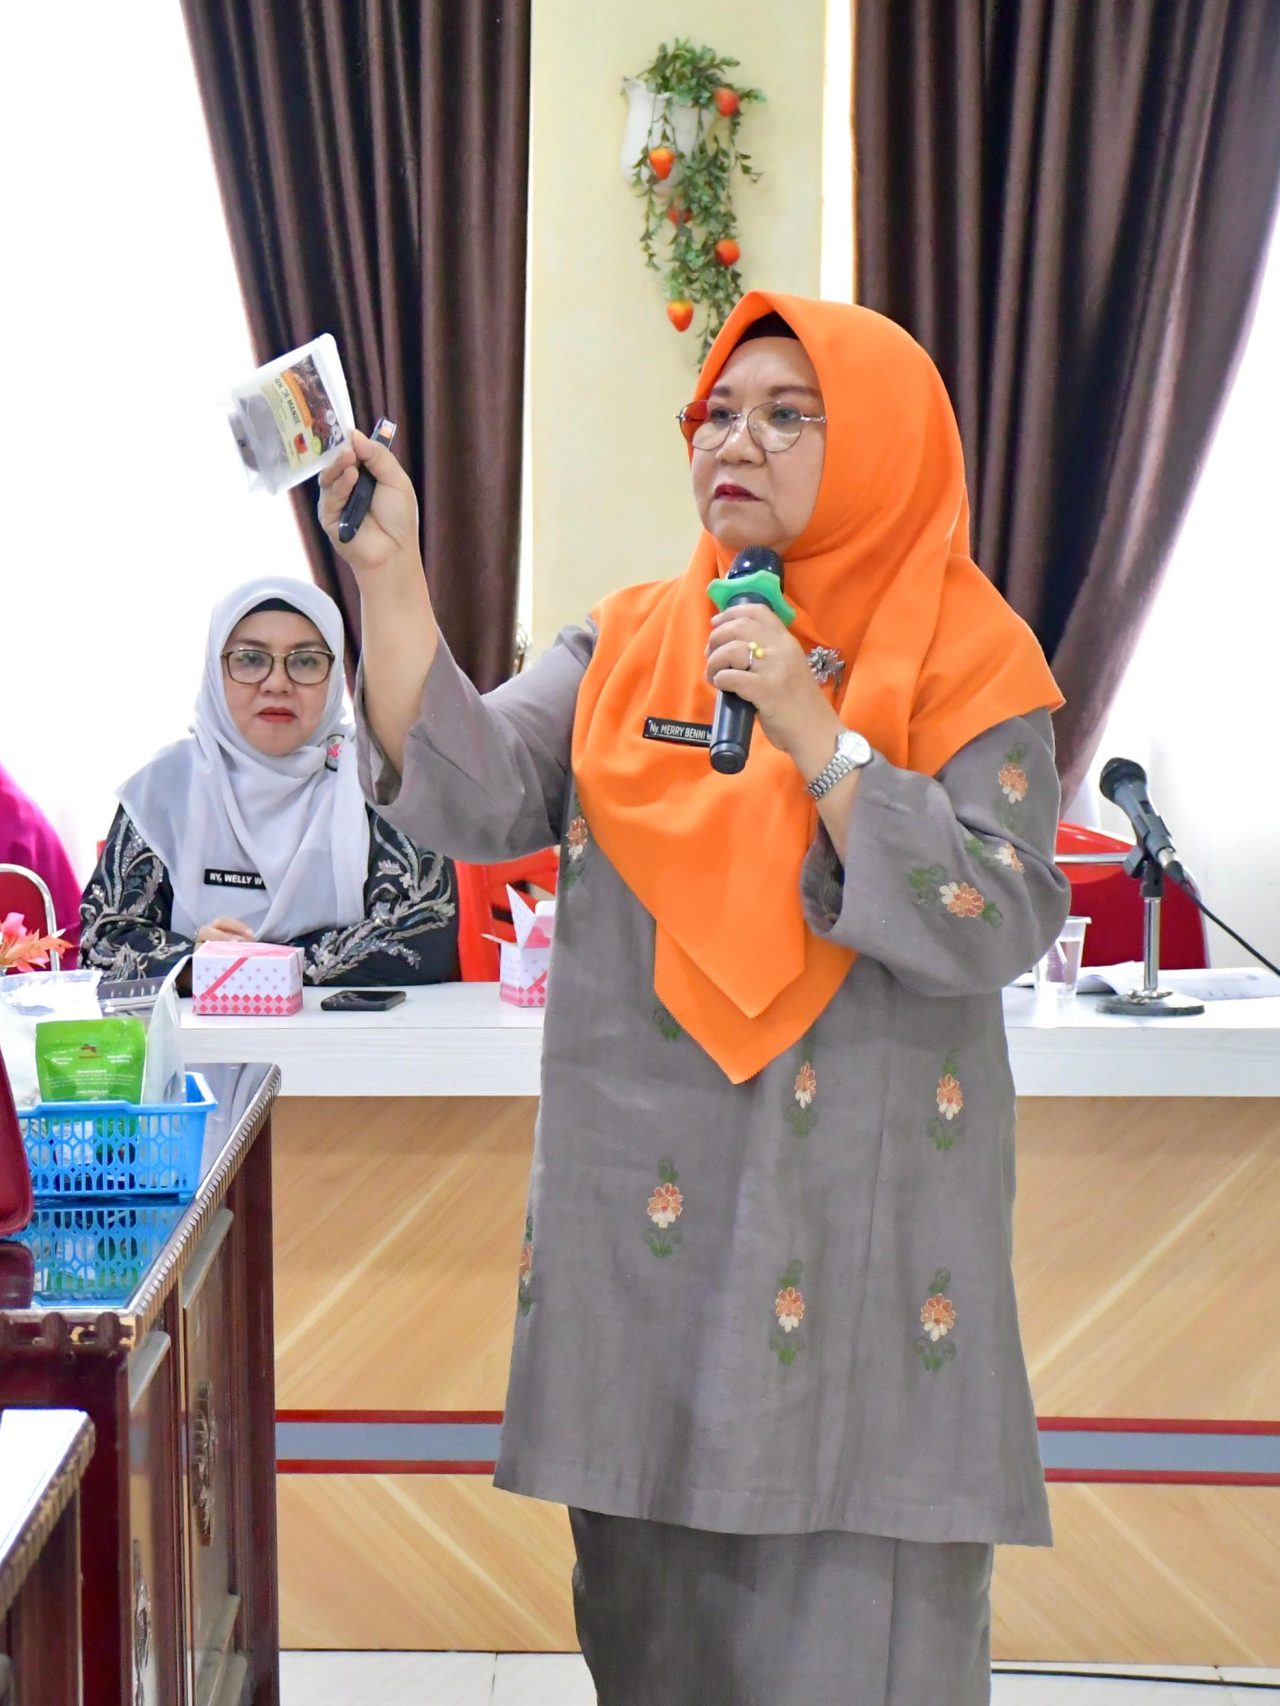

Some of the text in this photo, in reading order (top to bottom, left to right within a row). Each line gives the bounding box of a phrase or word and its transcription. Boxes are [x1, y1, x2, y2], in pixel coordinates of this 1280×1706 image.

[660, 724, 685, 737] MERRY
[684, 727, 706, 740] BENNI
[223, 873, 253, 885] WELLY
